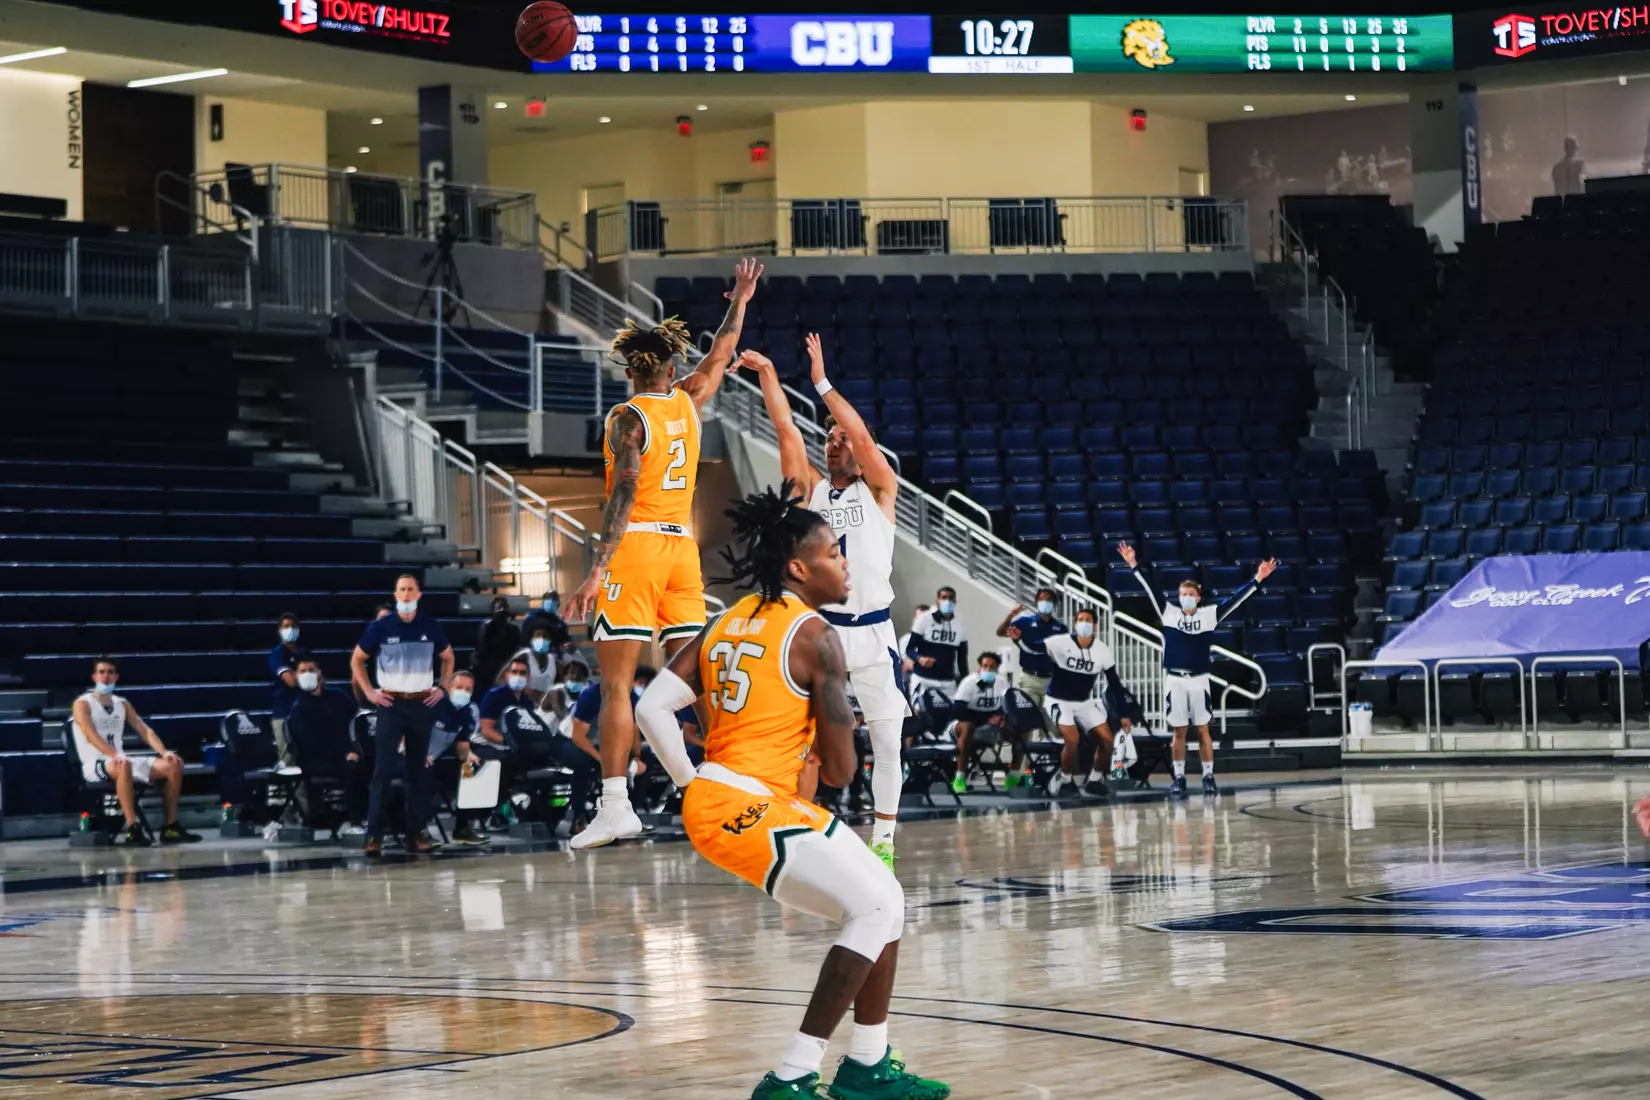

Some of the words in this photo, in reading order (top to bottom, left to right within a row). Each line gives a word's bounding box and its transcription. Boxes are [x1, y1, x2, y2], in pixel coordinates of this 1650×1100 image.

[620, 16, 630, 34] 1
[647, 16, 658, 34] 4
[676, 16, 687, 34] 5
[701, 16, 718, 34] 12
[729, 16, 747, 34] 25
[1247, 16, 1275, 34] PLYR
[1293, 17, 1302, 34] 2
[1320, 17, 1328, 34] 5
[1342, 17, 1356, 34] 13
[1368, 17, 1382, 34] 25
[1392, 17, 1407, 34] 35
[1540, 5, 1650, 35] TOVEY/SH
[619, 36, 630, 52] 0
[647, 36, 658, 52] 4
[676, 36, 687, 52] 0
[705, 36, 715, 52] 2
[733, 36, 744, 52] 0
[791, 21, 894, 66] CBU
[960, 19, 1034, 55] 10:27
[1246, 35, 1268, 52] PTS
[1292, 36, 1306, 52] 11
[1320, 36, 1328, 52] 0
[1346, 36, 1354, 52] 0
[1371, 36, 1379, 52] 3
[1397, 36, 1405, 52] 2
[570, 54, 596, 71] FLS
[619, 54, 630, 71] 0
[650, 54, 658, 71] 1
[678, 54, 687, 71] 1
[705, 54, 715, 71] 2
[733, 54, 744, 71] 0
[967, 61, 990, 73] 1ST
[1006, 60, 1042, 72] HALF
[1248, 54, 1271, 71] FLS
[1296, 54, 1304, 71] 1
[1322, 54, 1329, 71] 1
[1348, 54, 1355, 71] 1
[1372, 54, 1380, 71] 0
[1397, 54, 1405, 71] 0
[68, 90, 81, 169] WOMEN
[1465, 126, 1478, 209] CBU
[661, 437, 687, 491] 2
[931, 629, 957, 643] CBU
[1066, 656, 1095, 672] CBU
[709, 640, 767, 714] 35
[977, 697, 1001, 709] CBU
